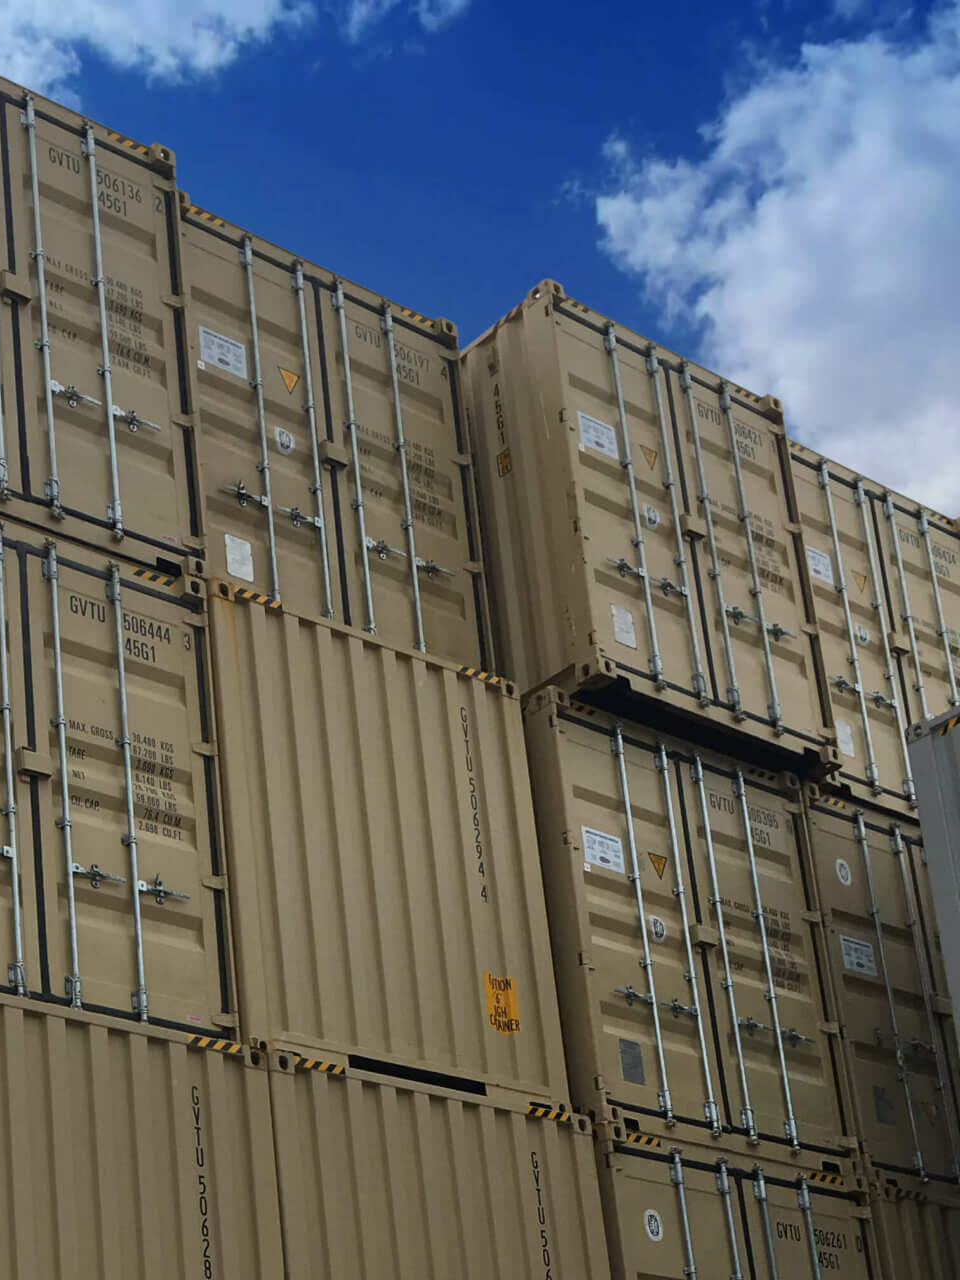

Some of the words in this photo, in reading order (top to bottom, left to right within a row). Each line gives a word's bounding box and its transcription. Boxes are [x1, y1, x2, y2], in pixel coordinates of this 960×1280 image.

[48, 146, 80, 175] GVTU
[96, 169, 142, 204] 506136
[154, 195, 163, 213] 2
[98, 191, 128, 217] 45G1
[69, 595, 106, 624] GVTU
[123, 612, 171, 645] 506444
[183, 633, 191, 651] 3
[125, 637, 157, 664] 45G1
[90, 725, 115, 741] GROSS
[191, 1085, 204, 1168] GVTU
[531, 1151, 545, 1225] GVTU
[776, 1221, 801, 1242] GVTU
